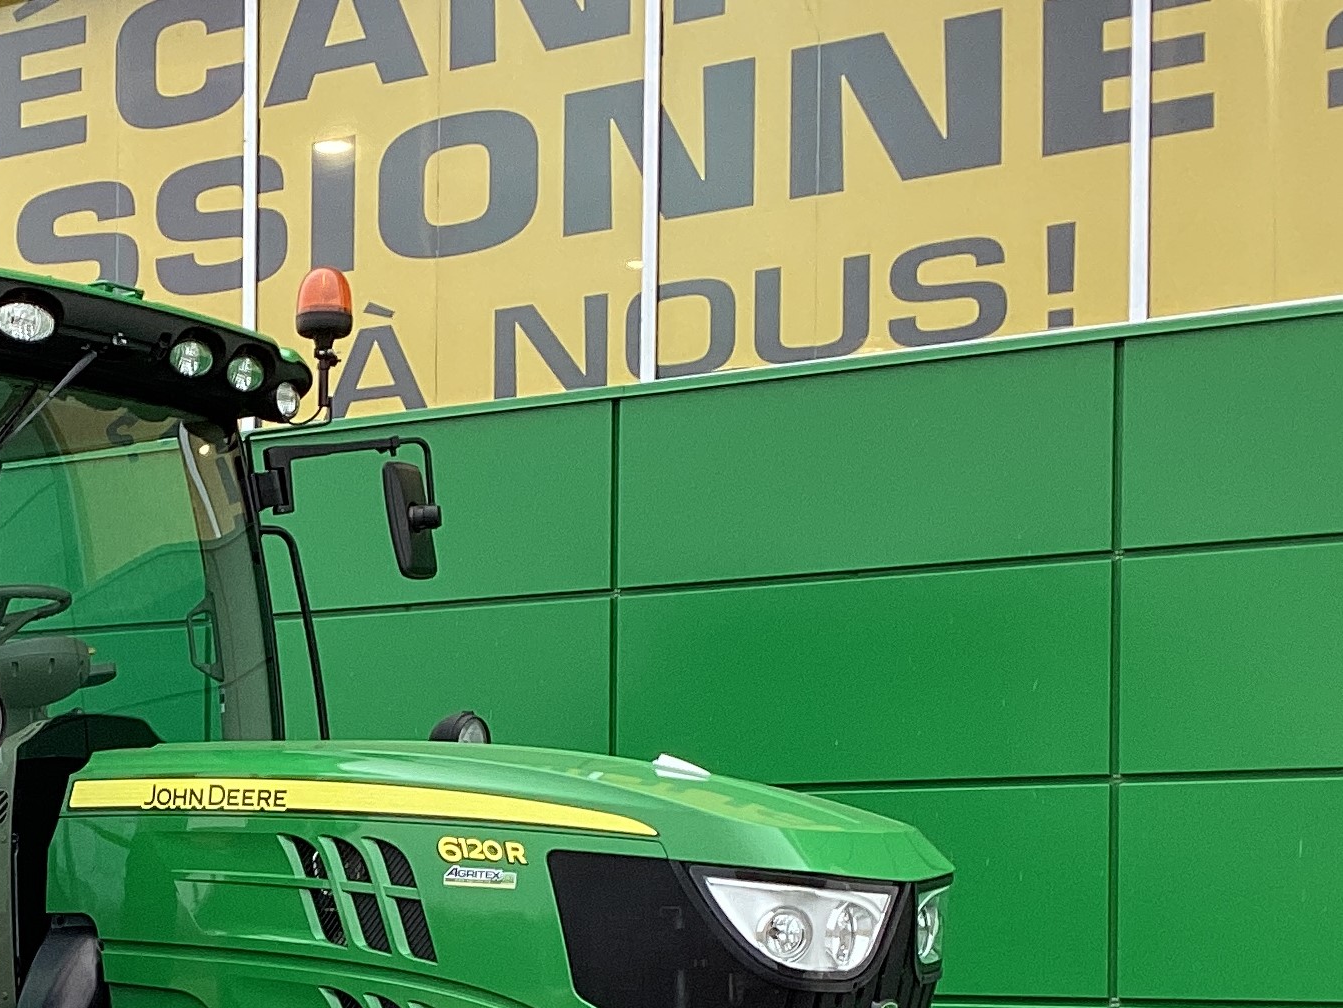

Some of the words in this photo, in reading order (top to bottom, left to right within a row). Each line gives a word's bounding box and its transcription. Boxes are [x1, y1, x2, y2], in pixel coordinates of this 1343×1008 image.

[143, 783, 204, 806] JOHN
[208, 784, 288, 807] DEERE
[445, 867, 502, 880] AGRITEX
